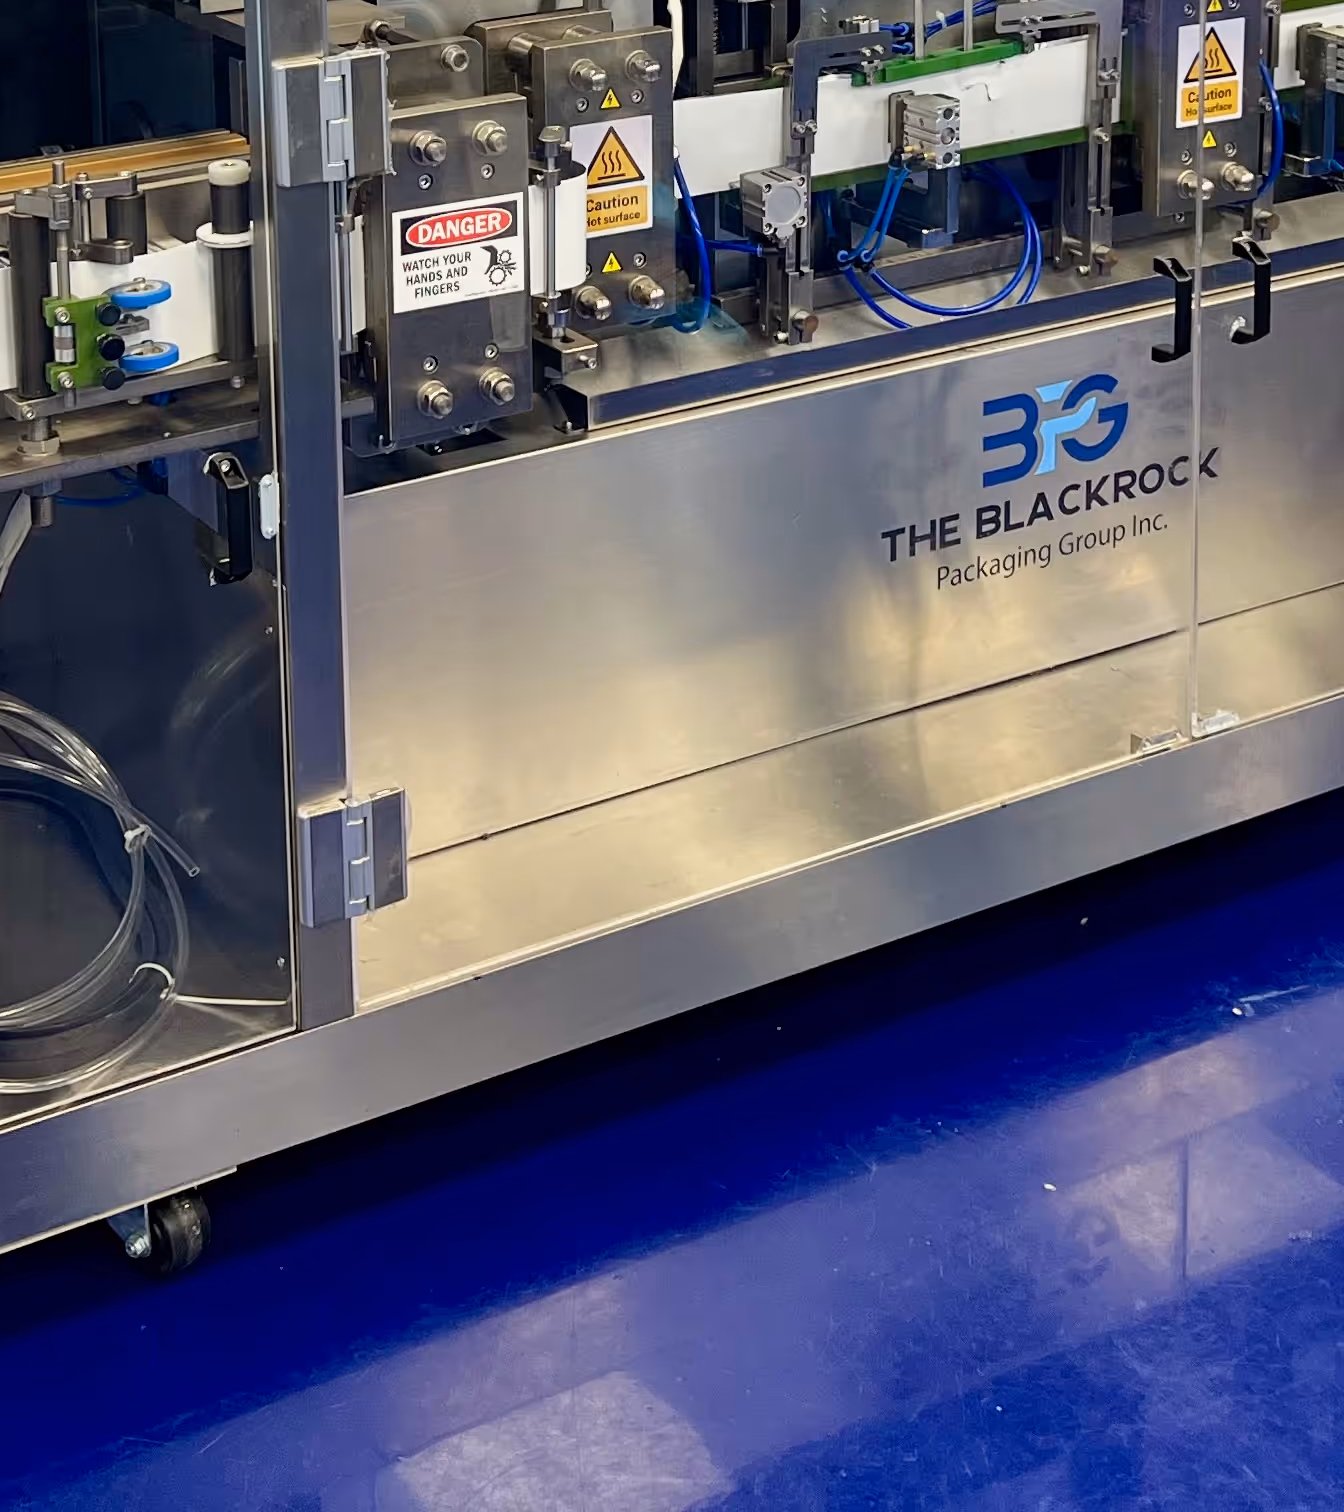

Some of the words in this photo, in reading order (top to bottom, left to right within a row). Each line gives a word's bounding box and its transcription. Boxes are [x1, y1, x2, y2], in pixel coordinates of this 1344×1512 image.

[587, 194, 639, 213] Caution
[417, 212, 503, 244] DANGER
[603, 211, 641, 225] surface
[402, 255, 440, 273] WATCH
[442, 251, 472, 267] YOUR
[406, 269, 444, 286] HANDS
[445, 265, 468, 280] AND
[414, 281, 461, 299] FINGERS
[881, 512, 961, 563] THE
[975, 446, 1220, 540] BLACKROCK
[937, 541, 1052, 590] Packaging
[1058, 523, 1126, 560] Group
[1132, 511, 1169, 538] Inc.
